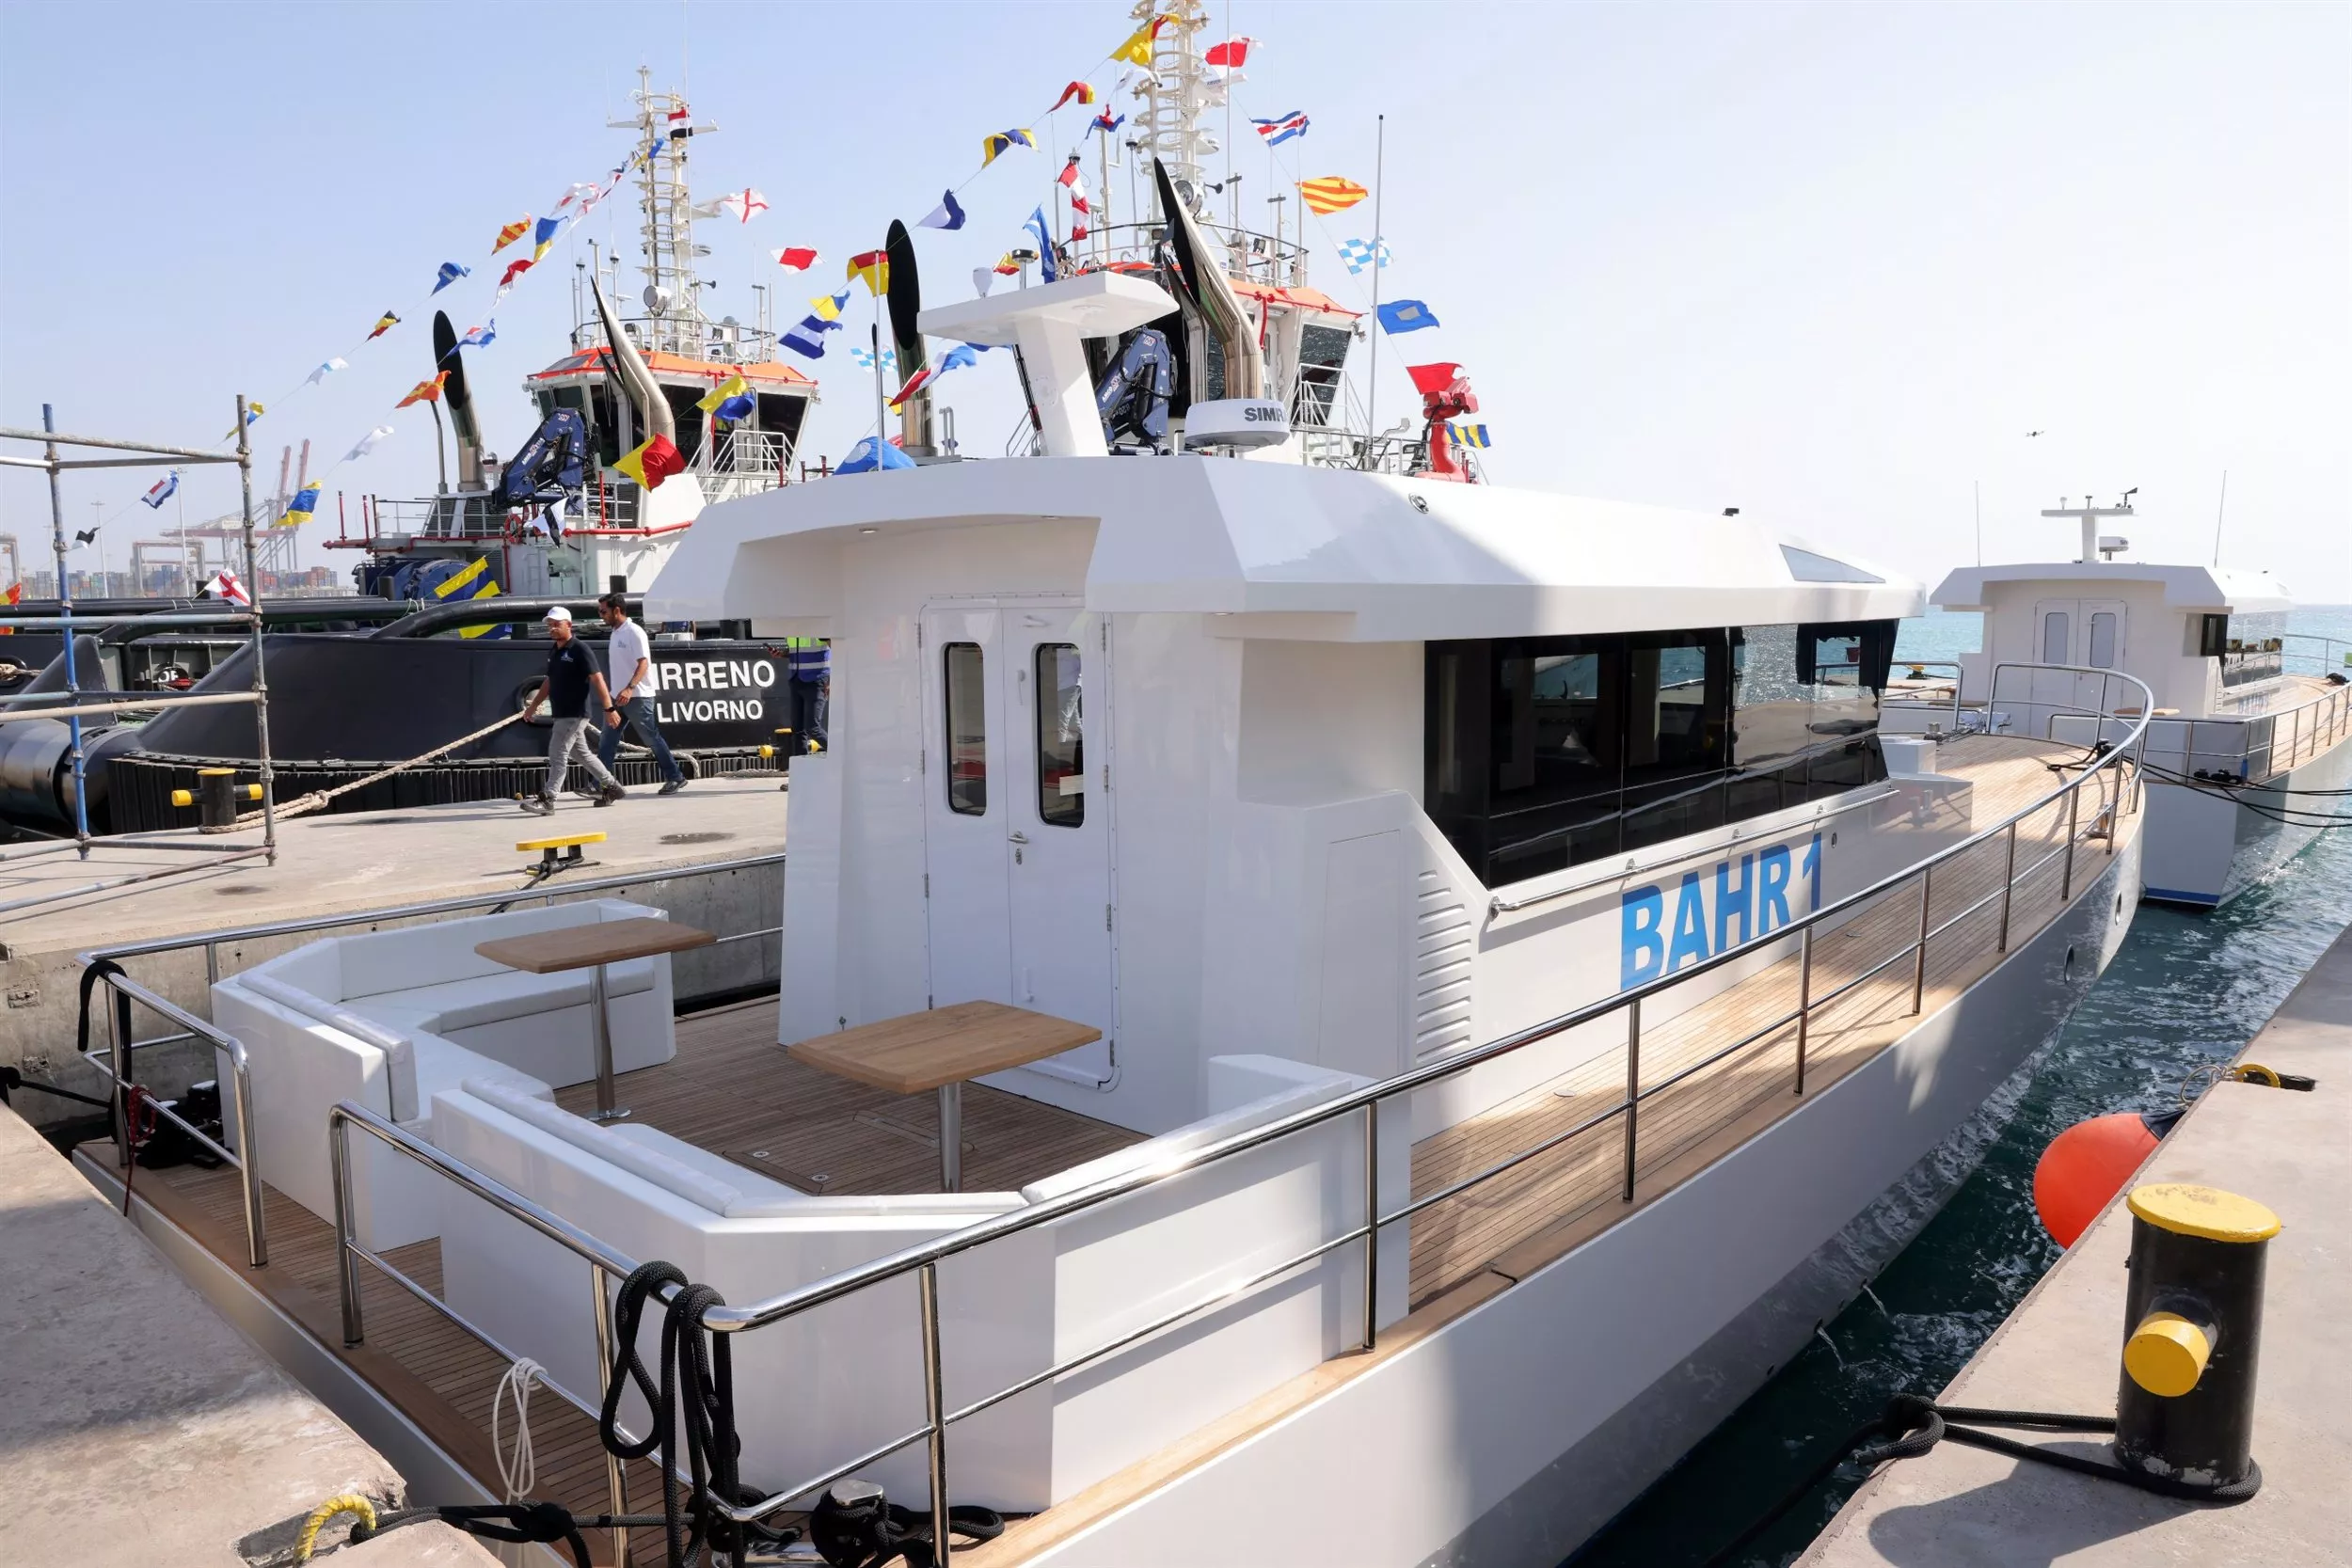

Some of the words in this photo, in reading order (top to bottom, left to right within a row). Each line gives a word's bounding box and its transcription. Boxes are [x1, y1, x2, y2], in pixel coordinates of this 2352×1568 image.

[1244, 406, 1285, 422] SIMR
[650, 660, 775, 690] IRRENO
[657, 699, 763, 723] LIVORNO
[1620, 844, 1791, 991] BAHR
[1802, 832, 1821, 912] 1
